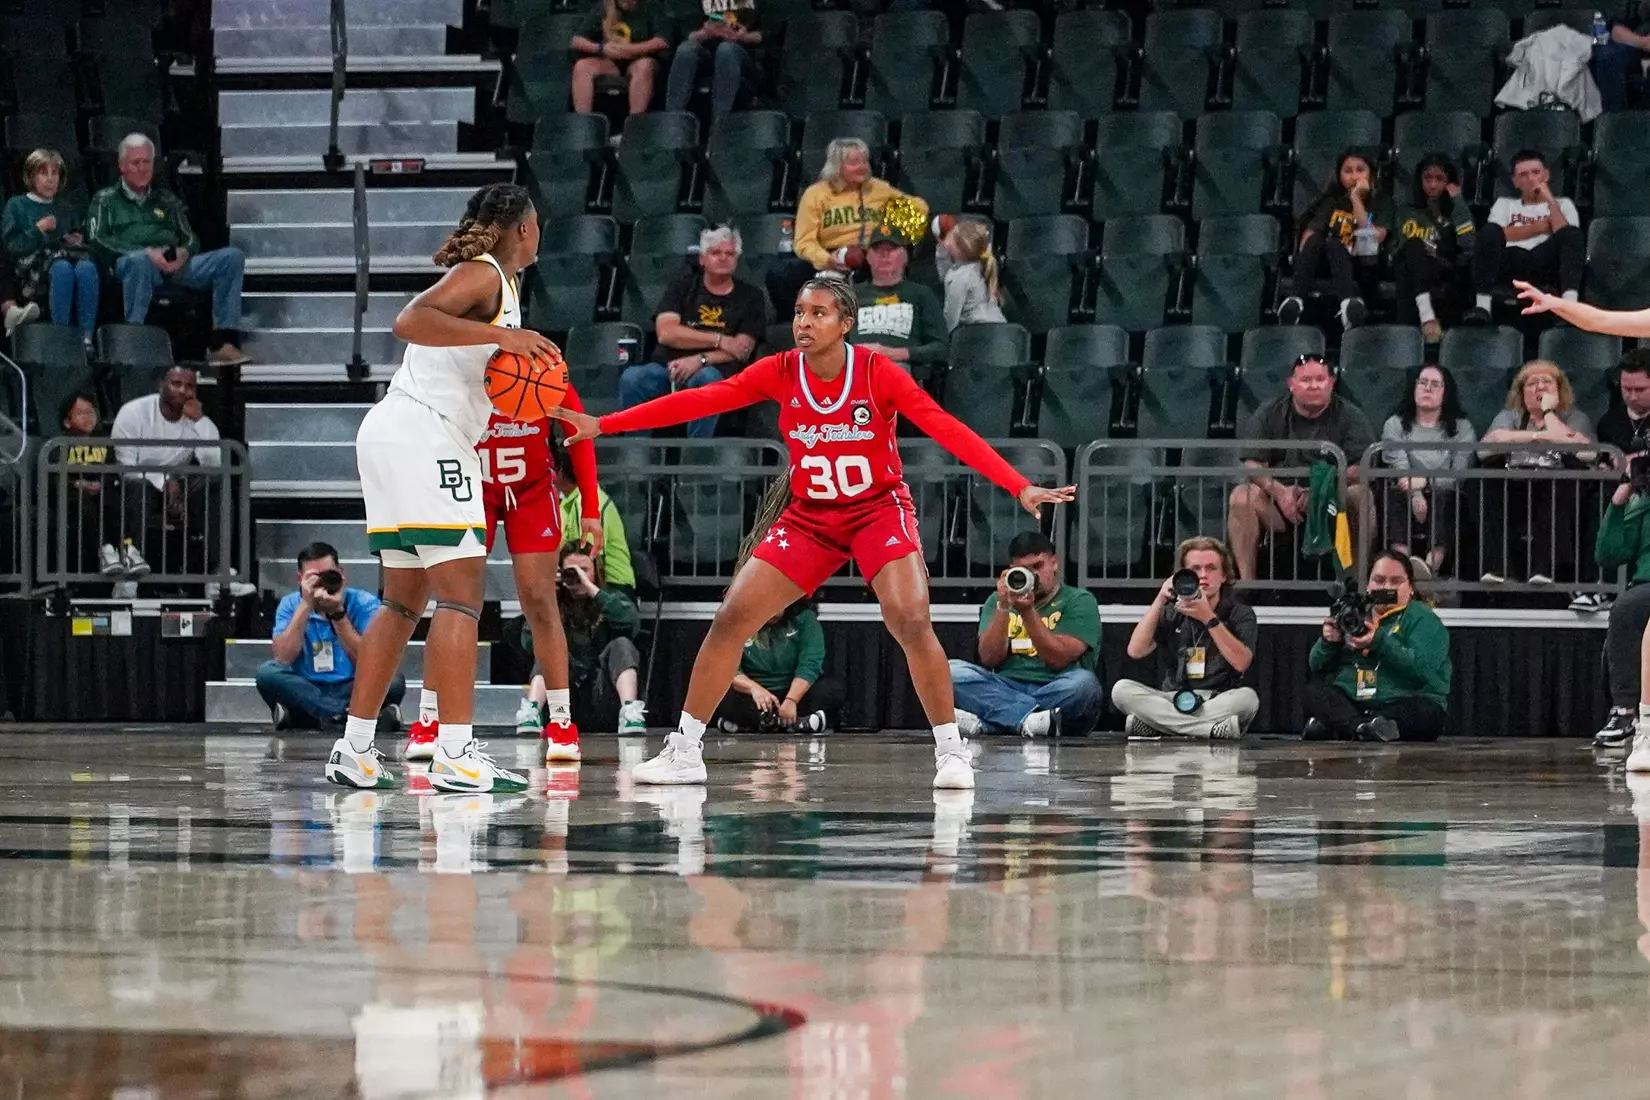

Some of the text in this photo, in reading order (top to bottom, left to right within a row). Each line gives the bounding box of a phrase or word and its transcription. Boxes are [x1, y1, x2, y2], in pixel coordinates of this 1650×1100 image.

[437, 459, 473, 502] BU
[478, 446, 527, 484] 15
[801, 454, 874, 500] 30
